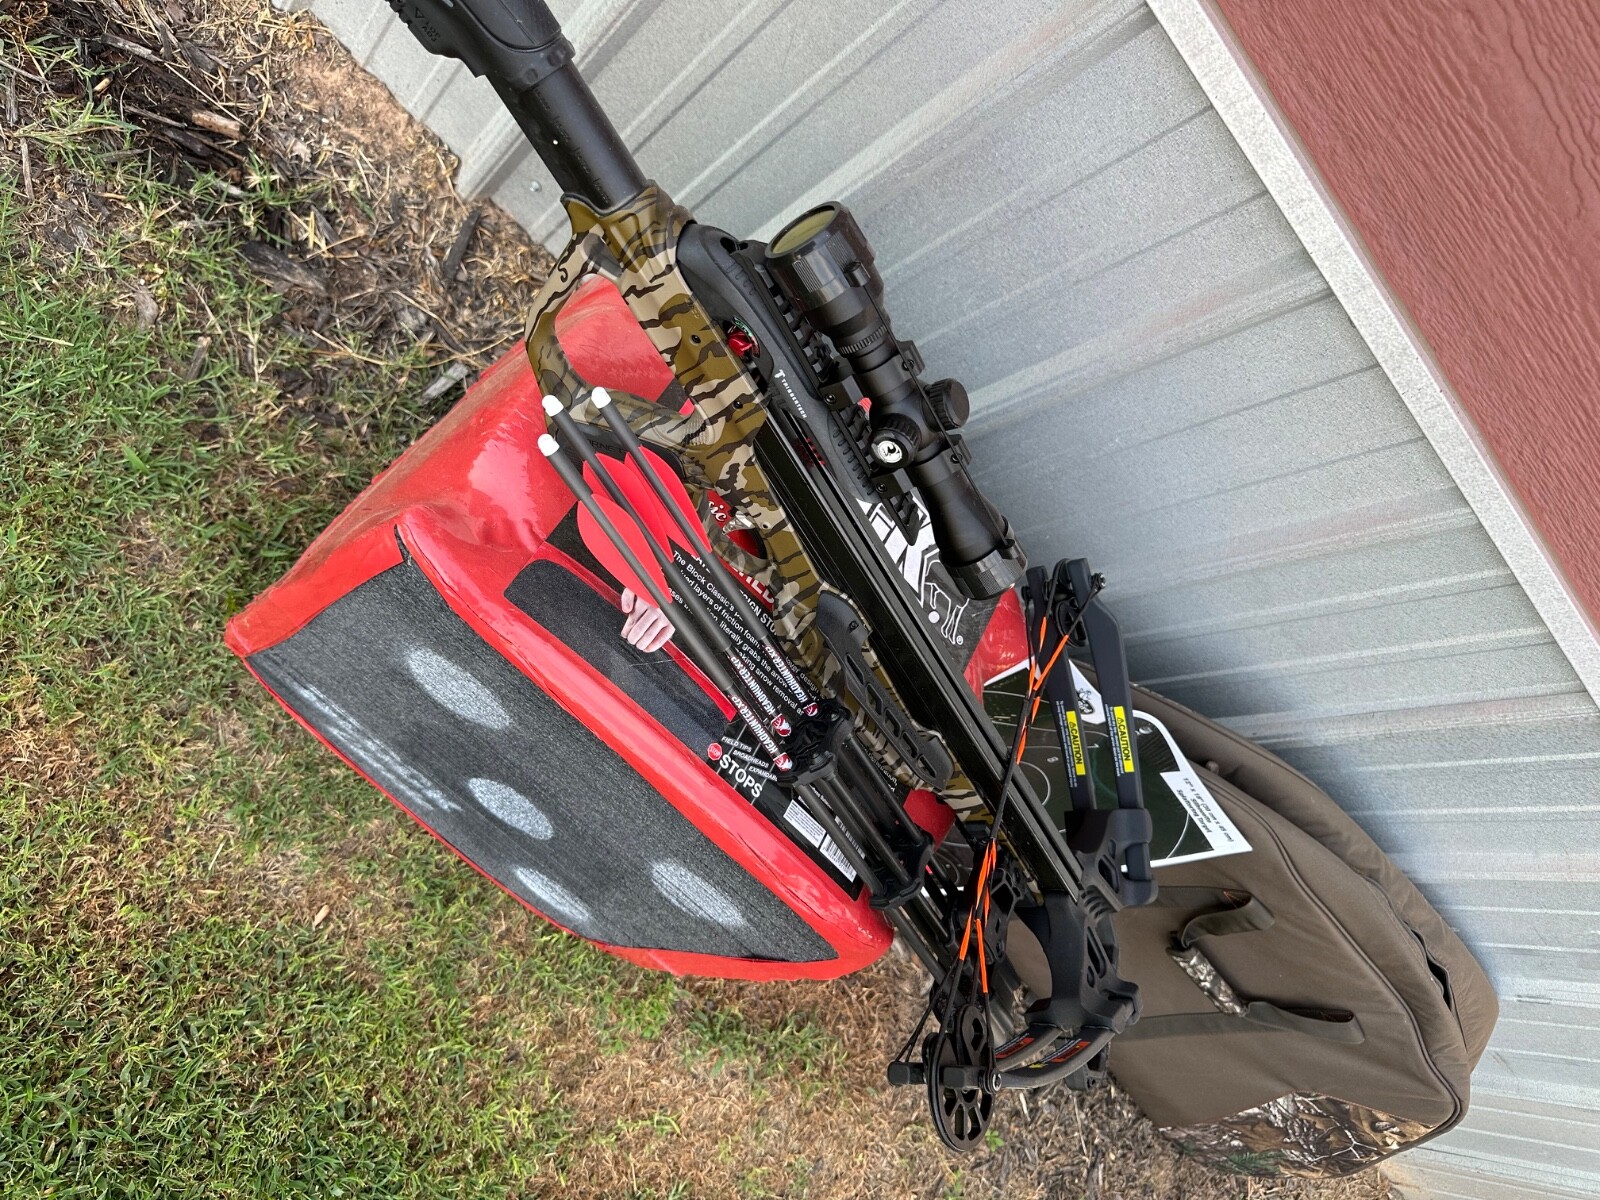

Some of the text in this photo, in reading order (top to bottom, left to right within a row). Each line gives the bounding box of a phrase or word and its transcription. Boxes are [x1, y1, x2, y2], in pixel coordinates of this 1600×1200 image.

[673, 550, 686, 566] The
[686, 563, 706, 585] Block
[706, 582, 735, 612] Classic's
[693, 583, 714, 606] layers
[713, 602, 723, 612] of
[720, 609, 744, 634] friction
[719, 620, 744, 646] literally
[741, 643, 761, 662] grabs
[760, 659, 772, 672] the
[770, 670, 788, 688] arrow
[765, 646, 778, 659] XP
[730, 656, 776, 716] HEADHUNTER XP
[755, 668, 773, 686] arrow
[772, 684, 798, 711] removal
[772, 655, 808, 703] HEADHUNTER
[721, 735, 753, 754] FIELD TIPS
[731, 696, 778, 754] HEADHUNTER XP
[1070, 729, 1083, 765] CAUTION
[1118, 724, 1131, 762] CAUTION
[719, 754, 763, 798] STOPS
[732, 749, 770, 769] BROADHEADS
